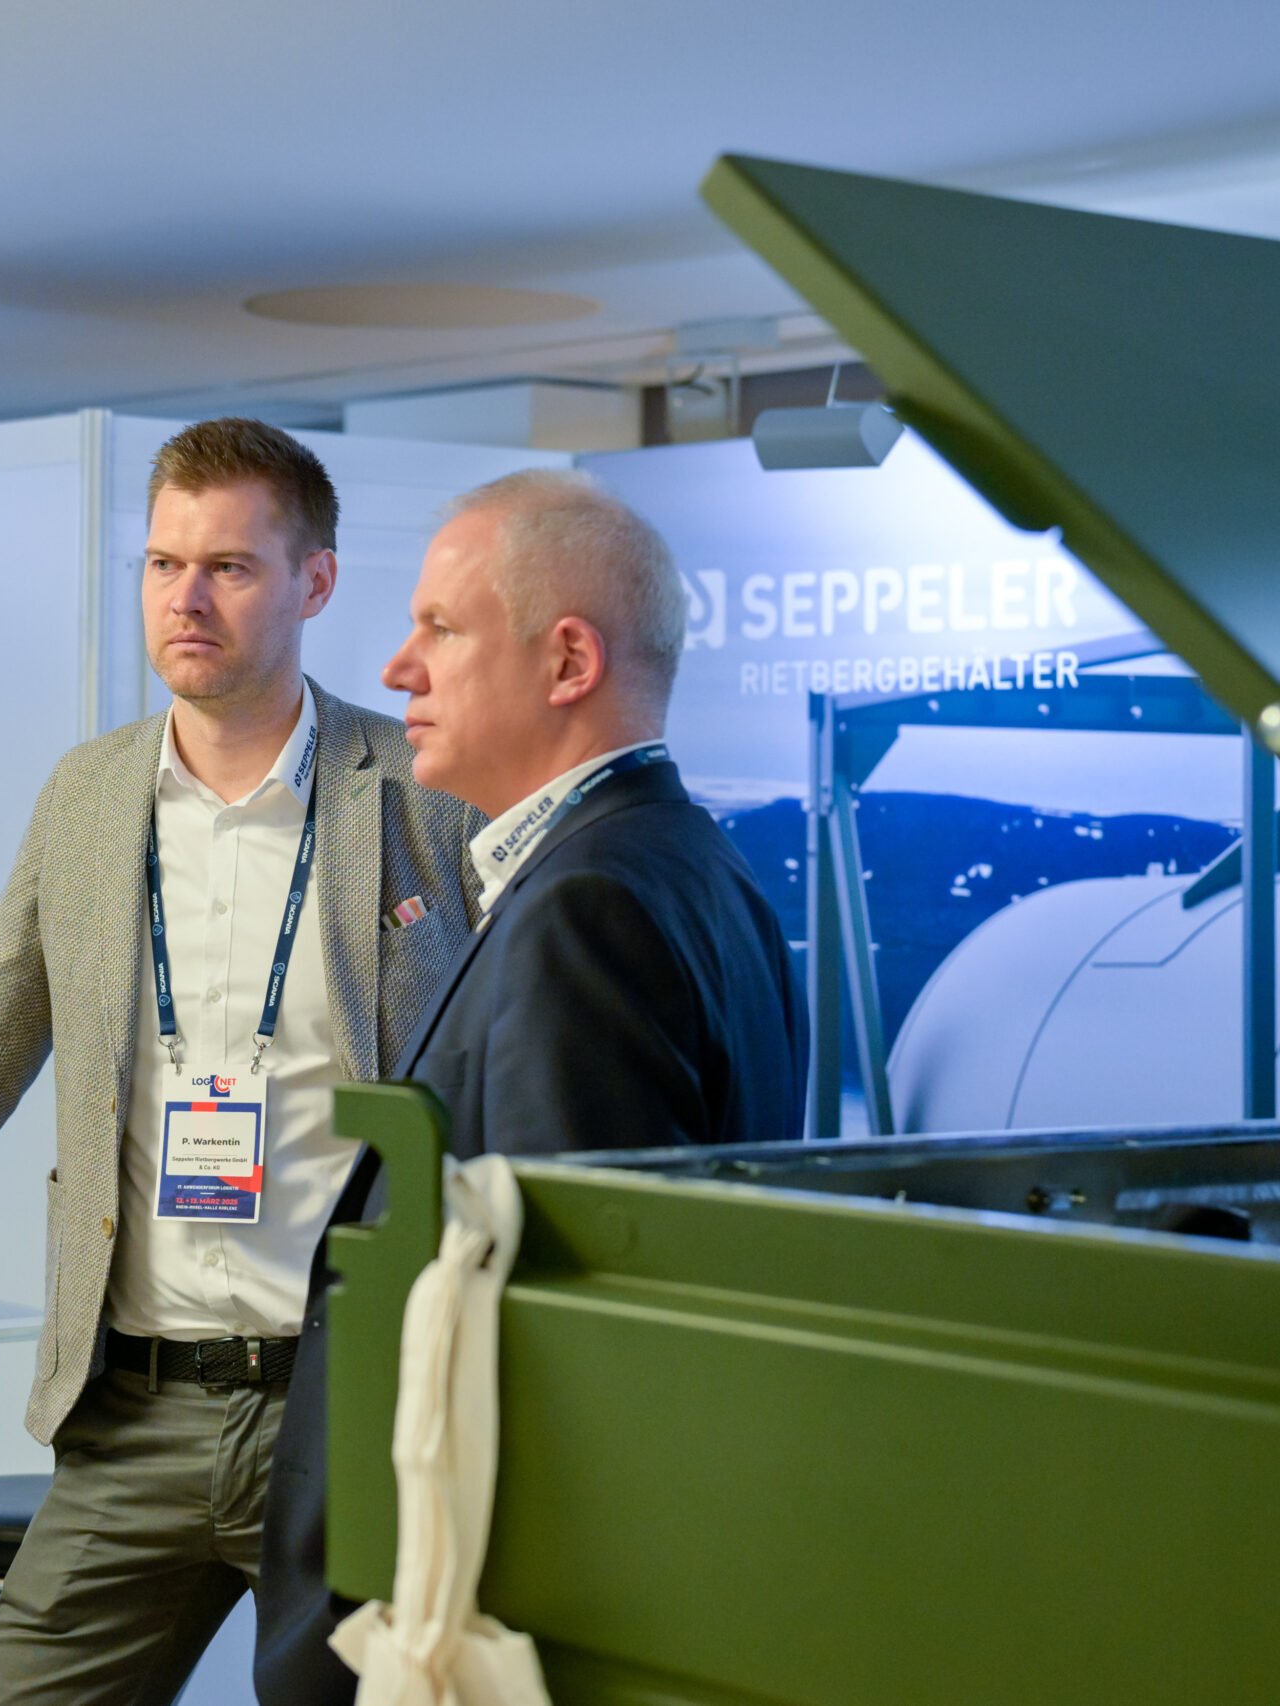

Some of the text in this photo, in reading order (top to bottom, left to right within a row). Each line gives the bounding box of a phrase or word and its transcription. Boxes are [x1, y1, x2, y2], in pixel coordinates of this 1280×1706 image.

[740, 560, 1078, 640] SEPPELER
[740, 648, 1080, 696] RIETBERGBEHÄLTER
[298, 725, 317, 775] SEPPELER
[504, 797, 554, 849] SEPPELER
[301, 834, 312, 864] SCANIA
[284, 904, 297, 935] SCANIA
[158, 962, 166, 993] SCANIA
[269, 975, 280, 1007] SCANIA
[193, 1138, 240, 1146] Warkentin
